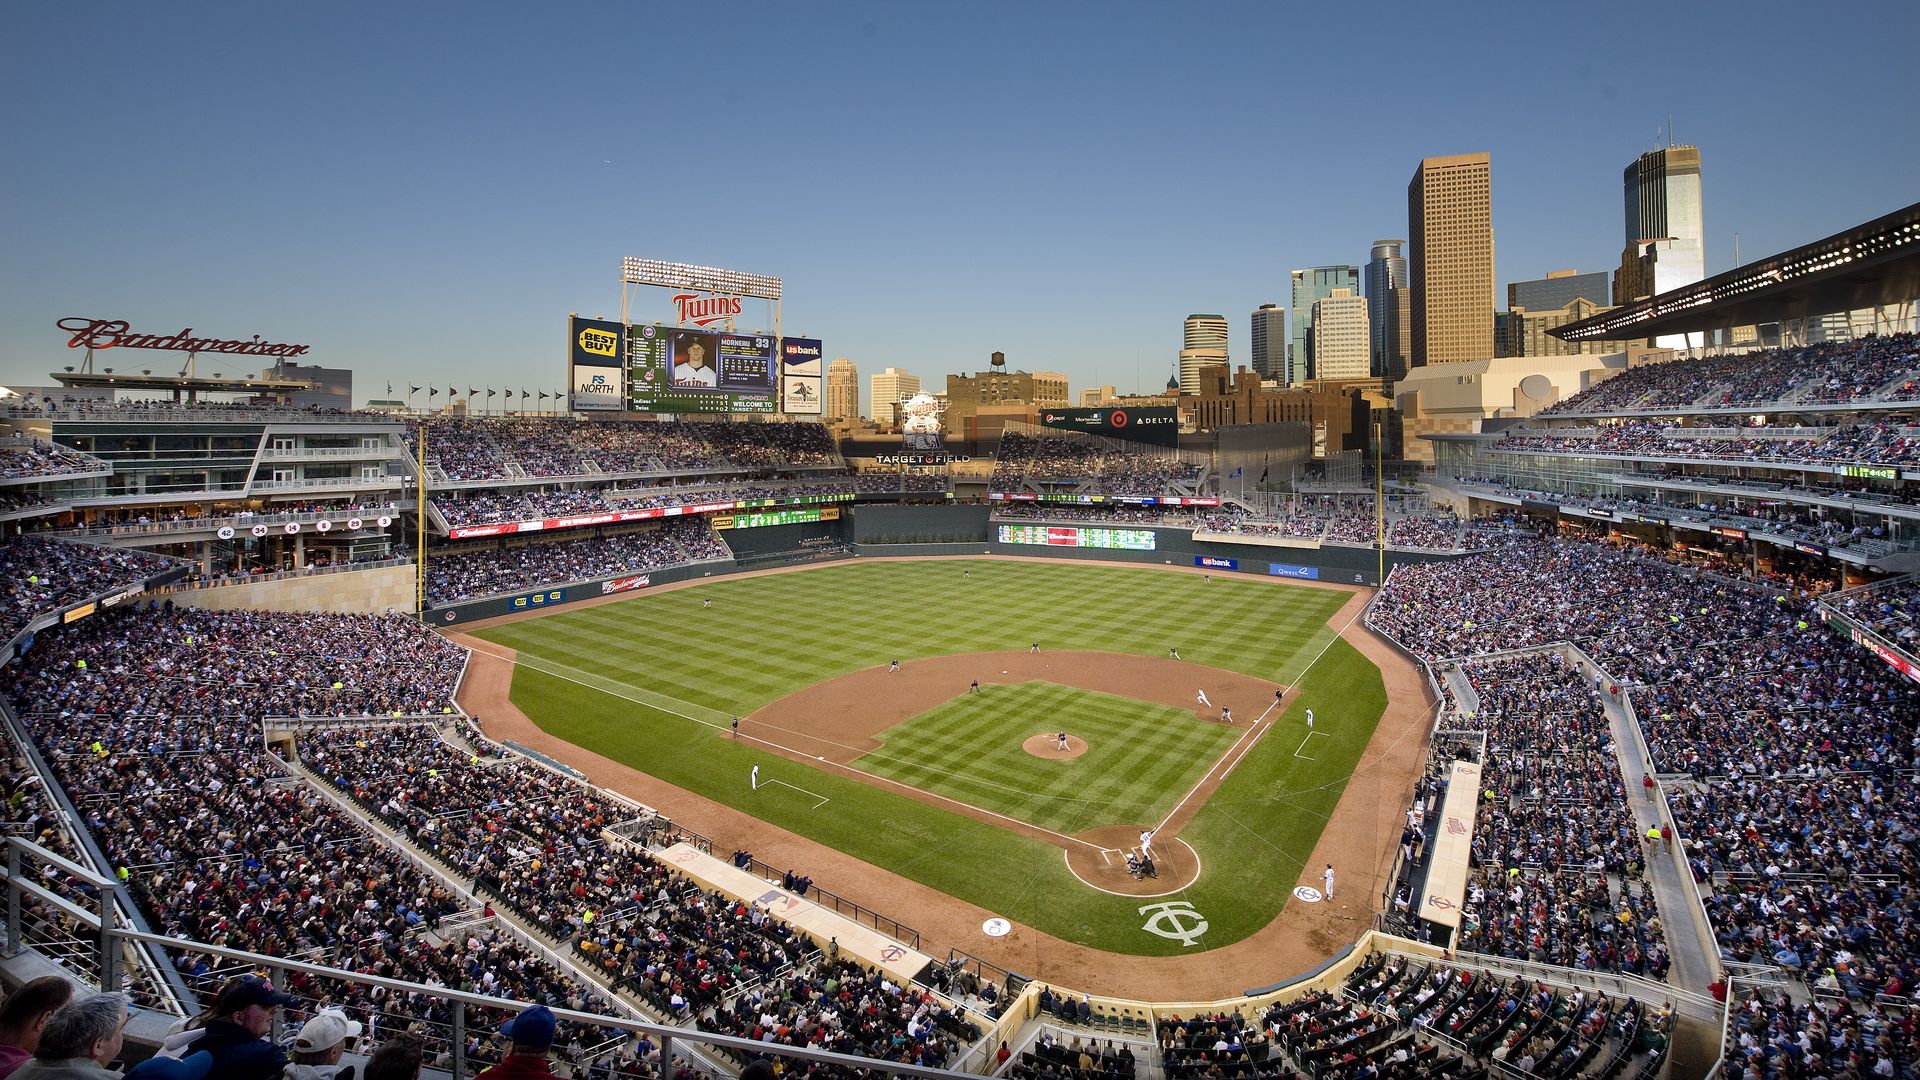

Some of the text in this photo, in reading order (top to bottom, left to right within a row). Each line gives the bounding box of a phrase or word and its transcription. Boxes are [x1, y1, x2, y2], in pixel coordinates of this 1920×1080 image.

[672, 291, 742, 323] Twins
[57, 317, 309, 357] Budweiser
[584, 332, 616, 345] BEST
[585, 342, 612, 352] BUY
[756, 338, 769, 348] 33
[592, 375, 605, 384] FS
[581, 384, 614, 394] NORTH
[876, 455, 923, 463] TARGET
[1278, 568, 1298, 576] Qwest
[606, 574, 648, 592] Budweiser
